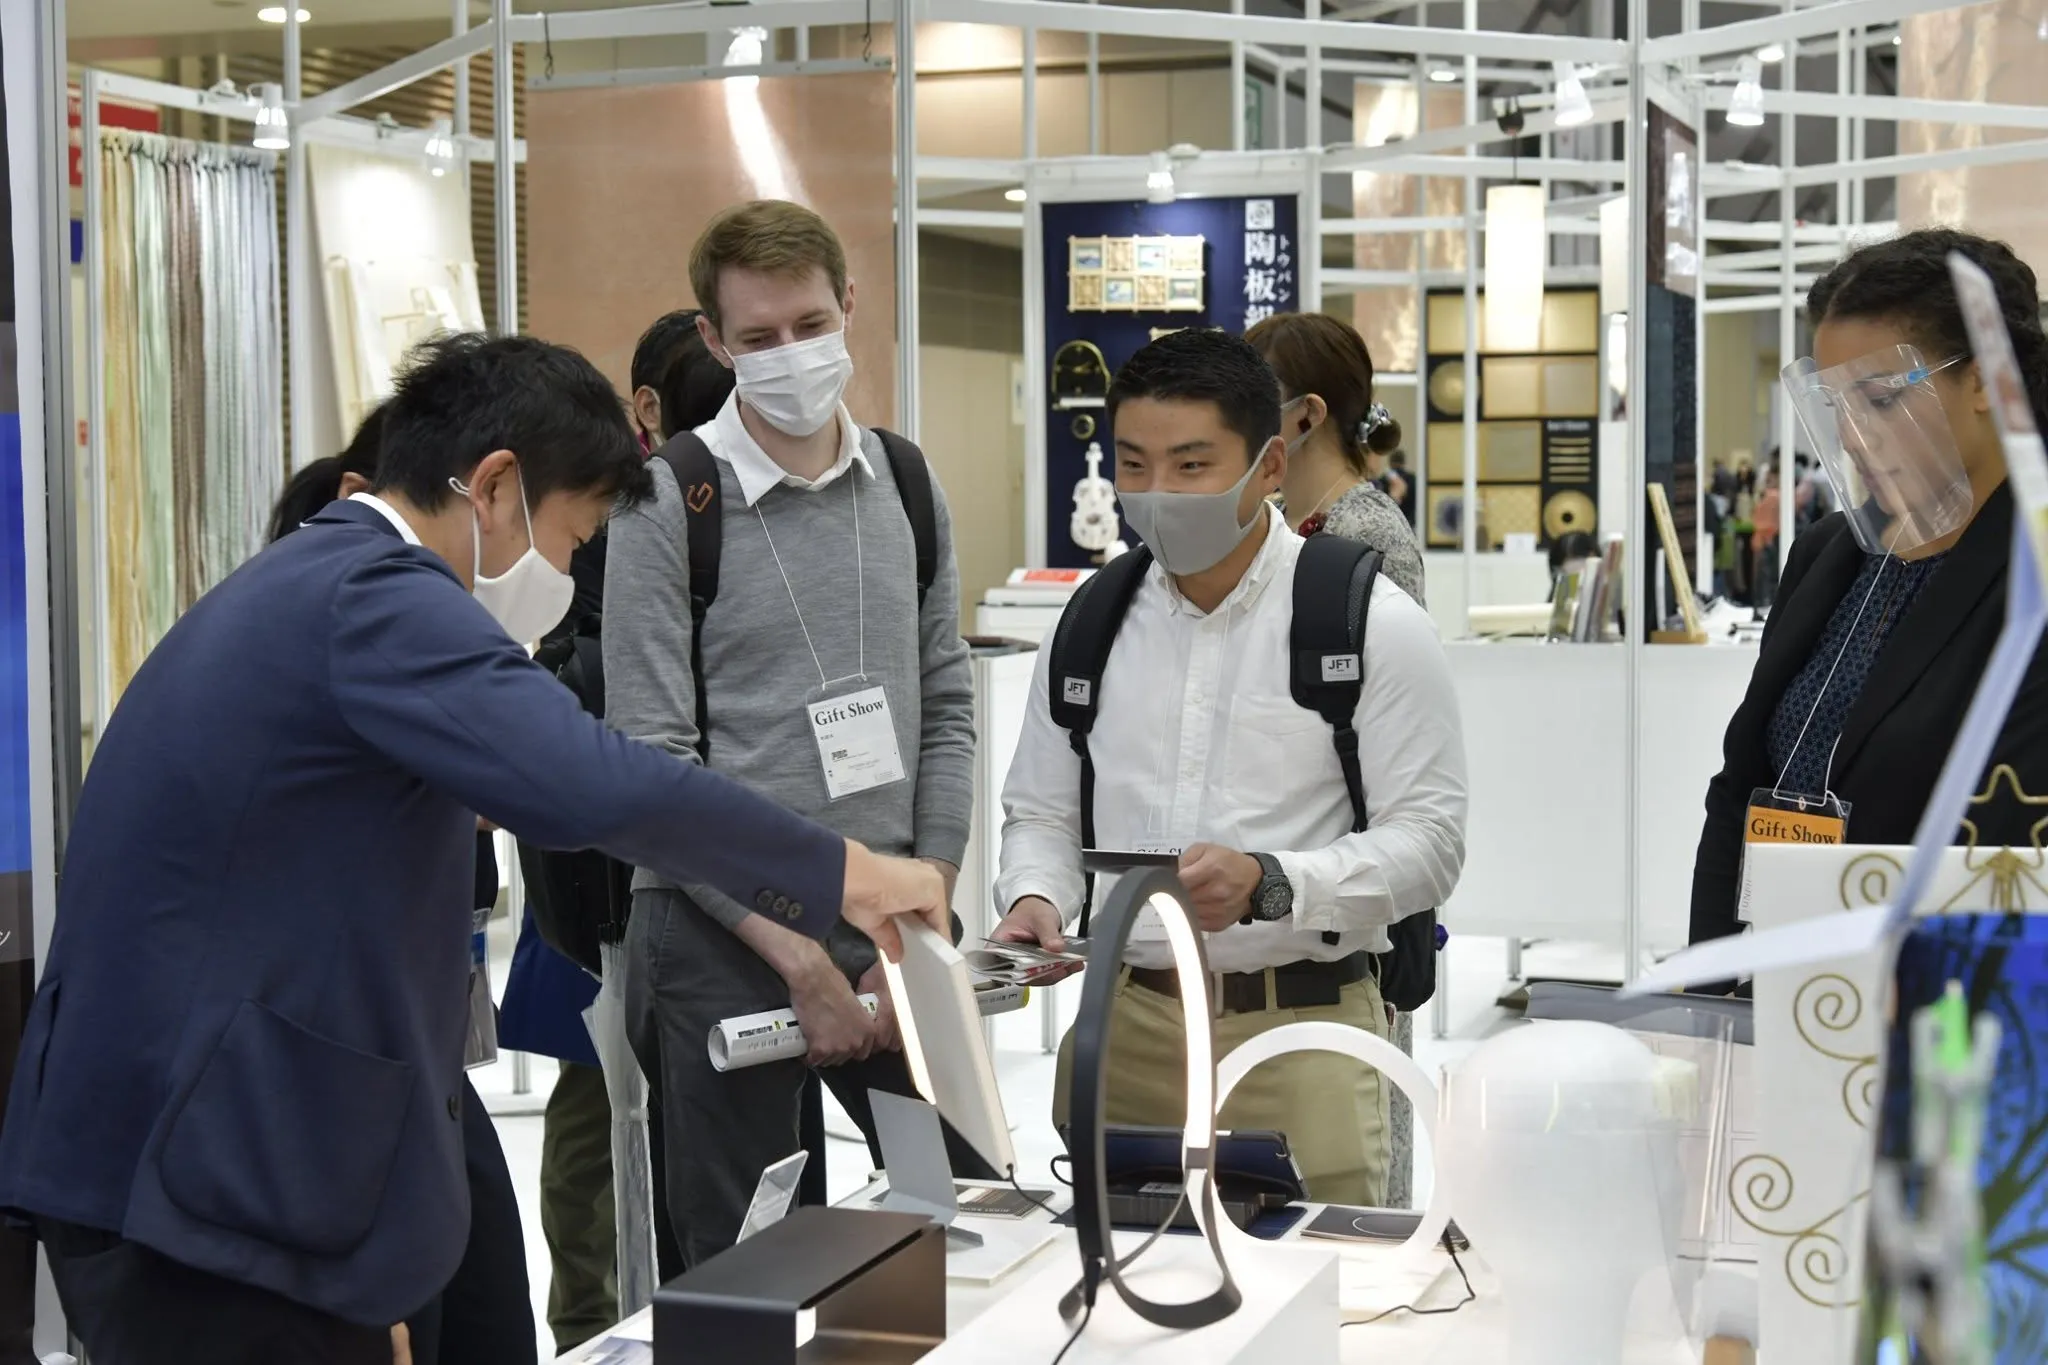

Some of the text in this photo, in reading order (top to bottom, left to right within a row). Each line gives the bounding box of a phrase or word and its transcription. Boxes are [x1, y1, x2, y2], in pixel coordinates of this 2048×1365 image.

[815, 700, 885, 726] Gift Show
[1751, 818, 1837, 844] Gift Show
